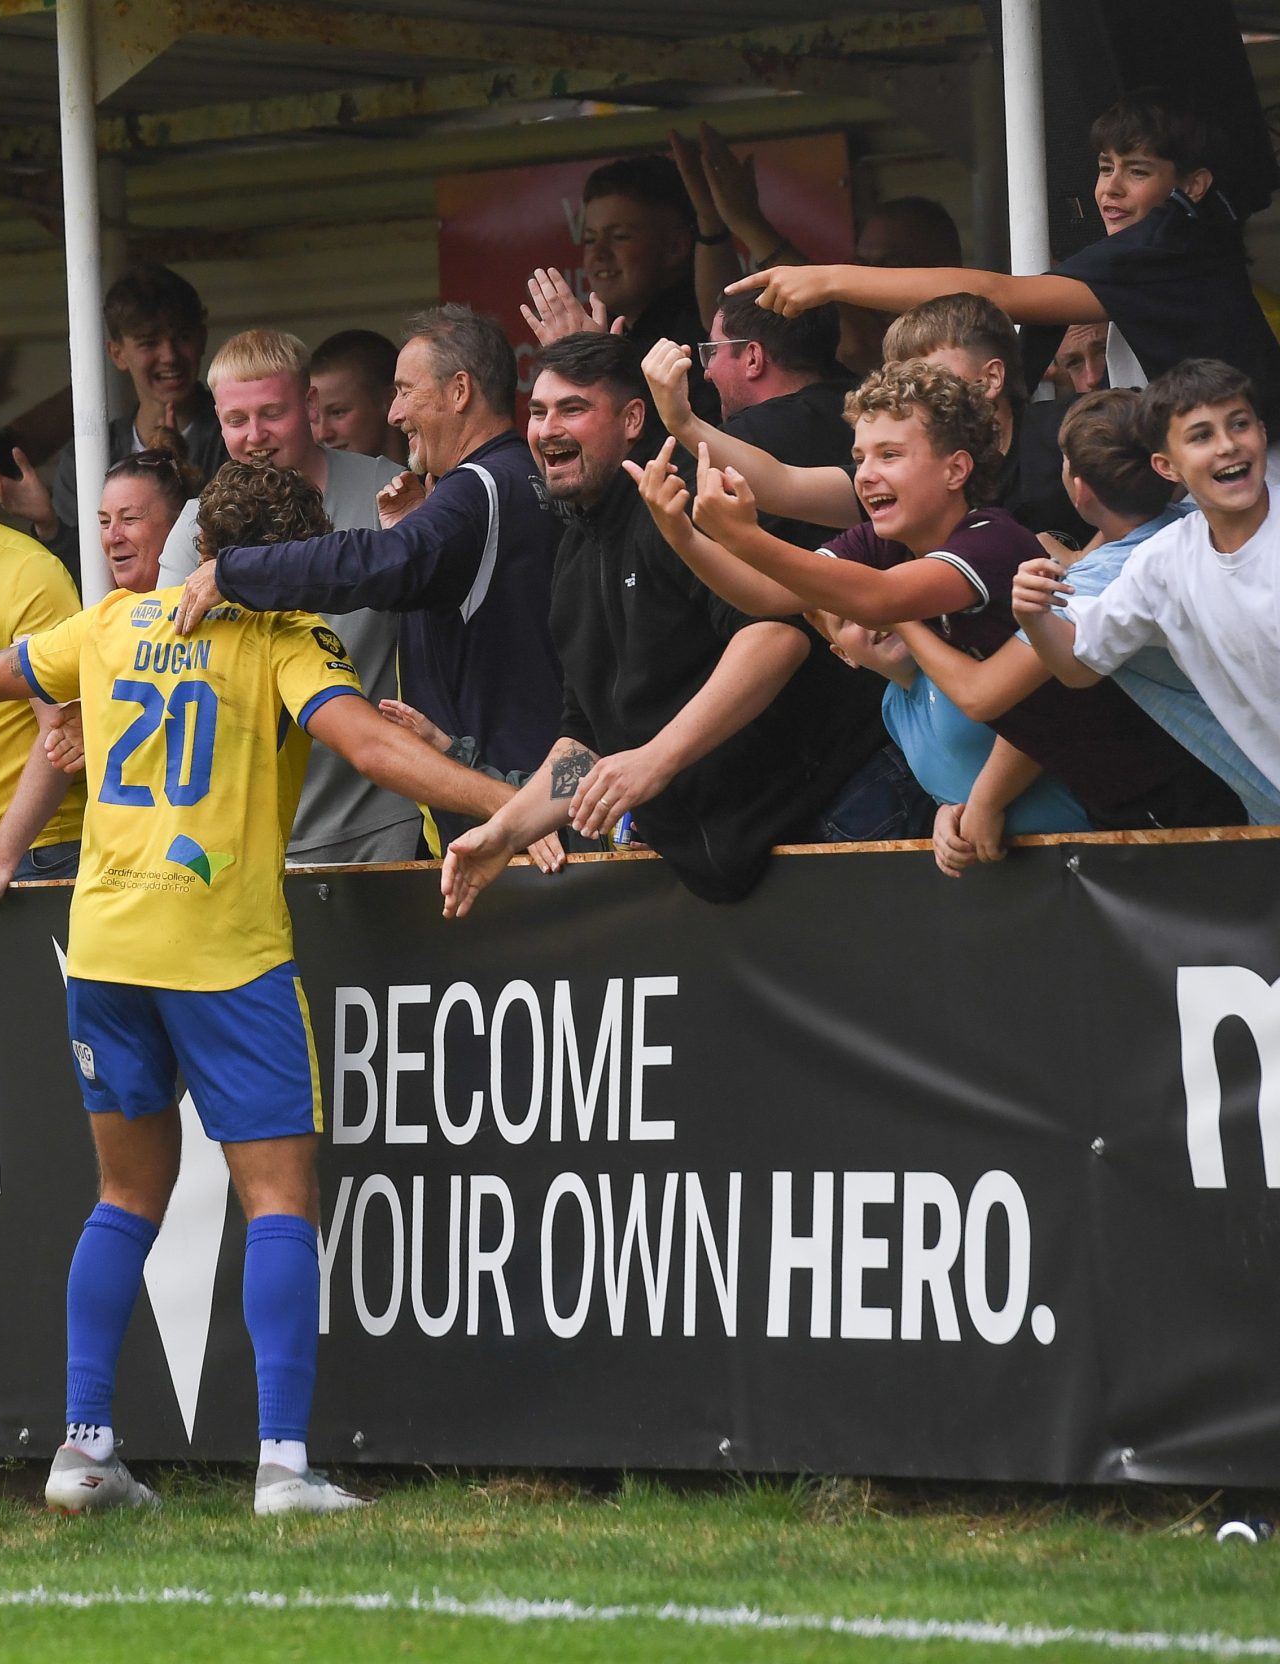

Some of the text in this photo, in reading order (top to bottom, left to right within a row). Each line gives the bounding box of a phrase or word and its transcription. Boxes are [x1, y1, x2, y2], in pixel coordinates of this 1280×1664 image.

[133, 606, 157, 620] NAPA
[133, 639, 212, 675] DUGAN
[98, 679, 219, 807] 20
[100, 876, 127, 889] Coleg
[174, 884, 190, 893] Fro
[162, 872, 196, 884] College
[332, 976, 678, 1145] BECOME
[317, 1169, 1056, 1345] YOUR OWN HERO.
